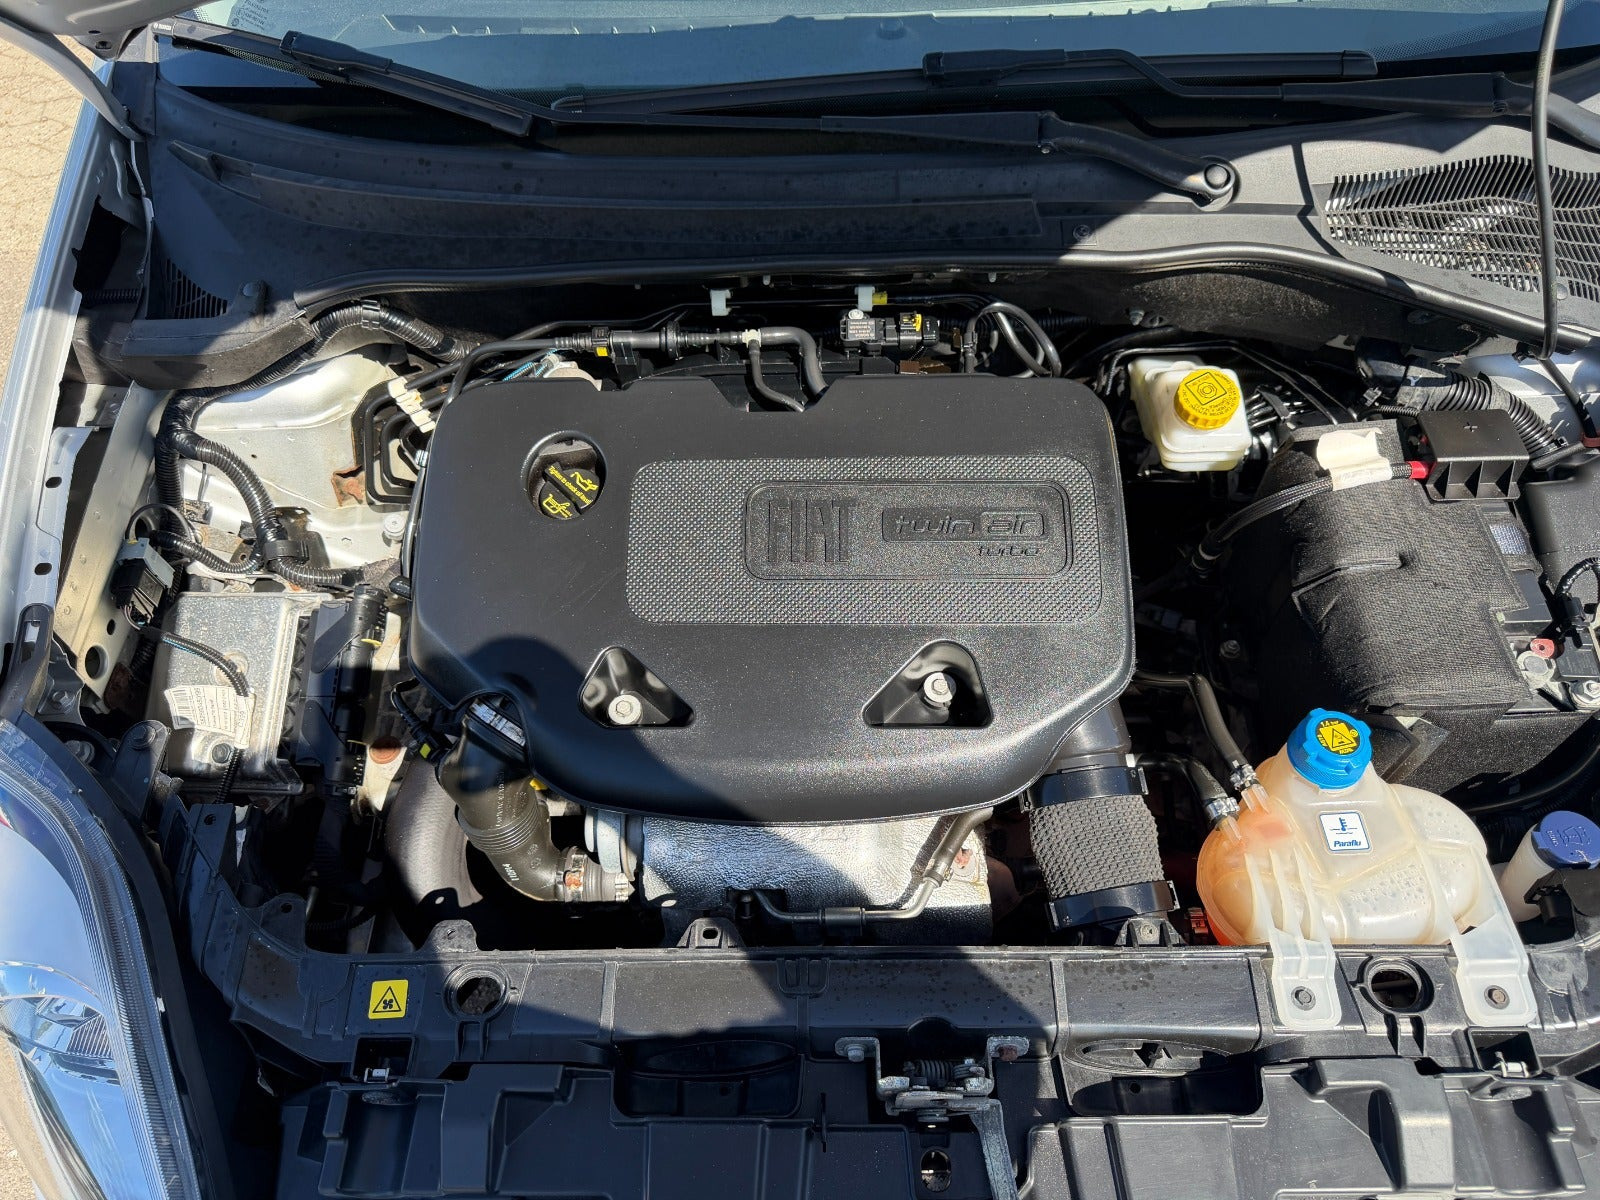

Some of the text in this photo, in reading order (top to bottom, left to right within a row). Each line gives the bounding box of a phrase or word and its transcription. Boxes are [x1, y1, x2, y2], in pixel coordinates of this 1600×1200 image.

[766, 498, 1037, 563] FIAT twin air
[977, 544, 1040, 557] turbo
[1333, 840, 1361, 848] Paraflu
